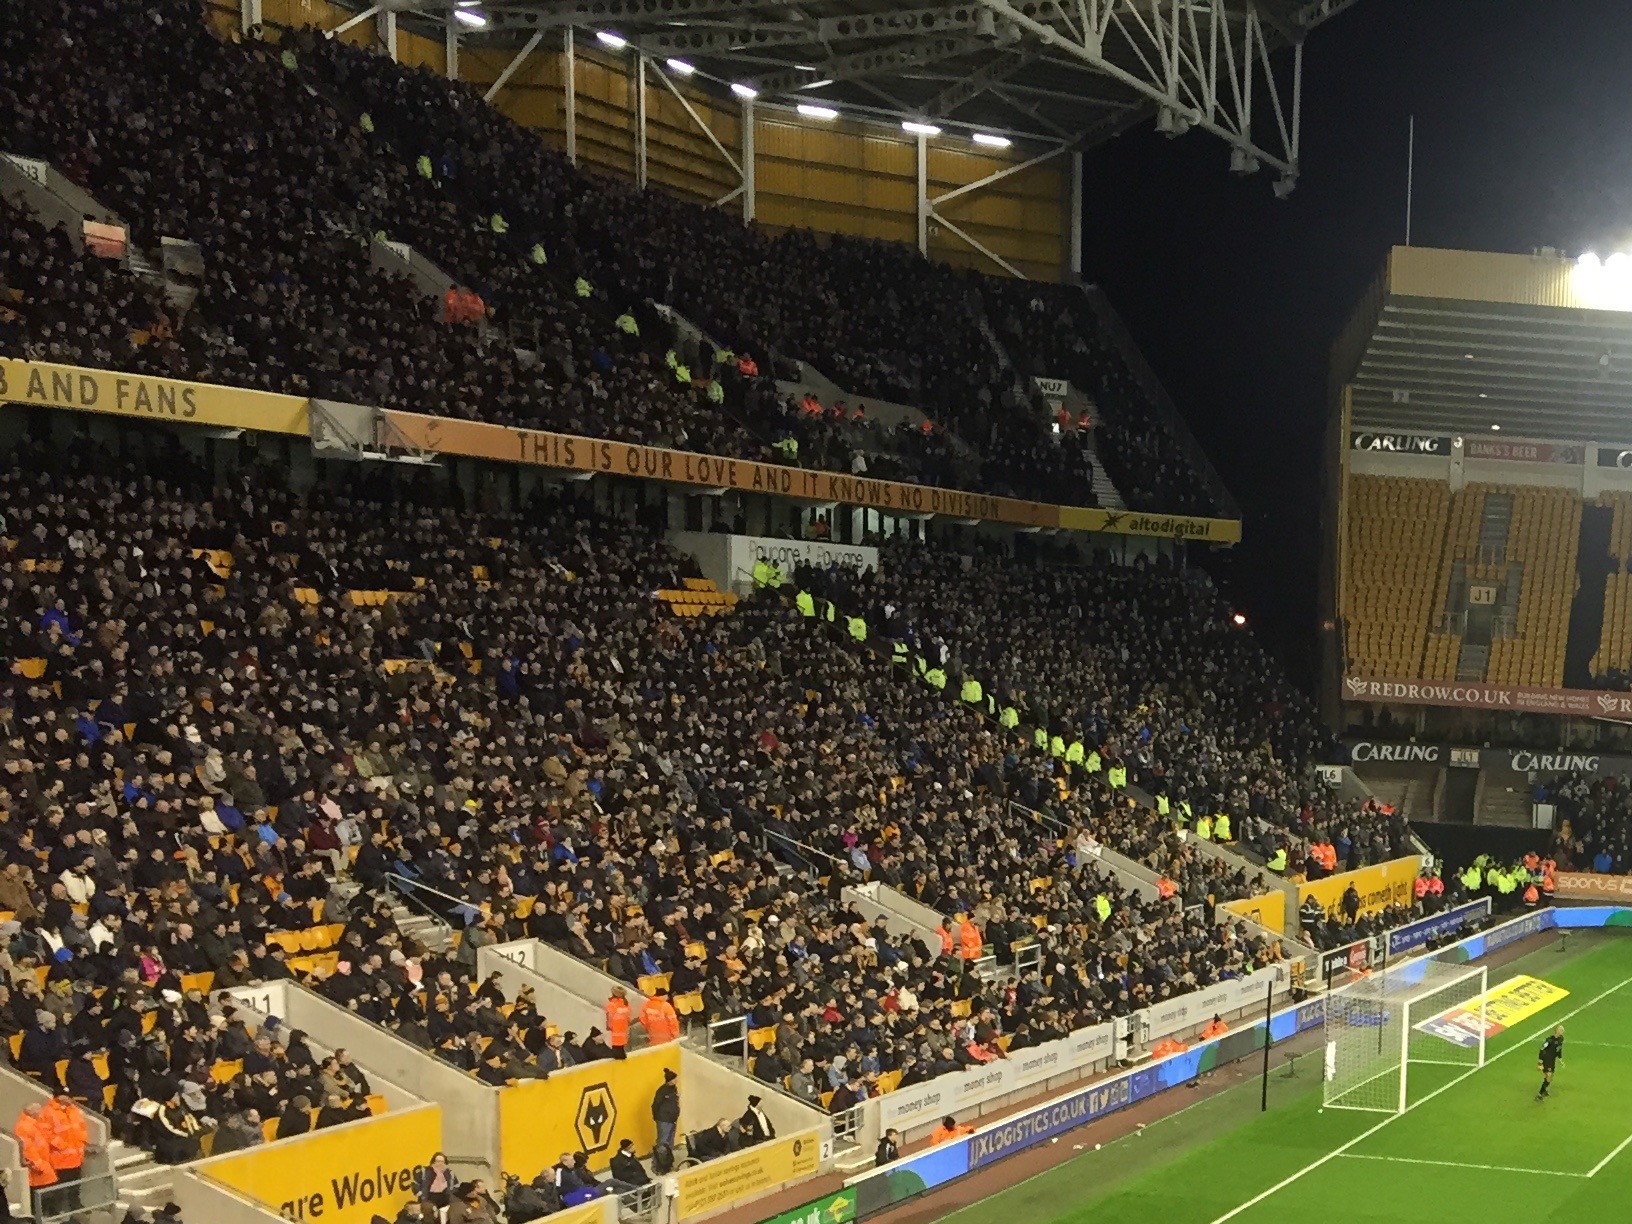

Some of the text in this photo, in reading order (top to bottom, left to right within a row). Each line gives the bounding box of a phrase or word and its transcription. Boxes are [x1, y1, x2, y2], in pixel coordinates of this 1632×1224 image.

[27, 368, 197, 418] AND FANS
[1355, 432, 1439, 452] CARLING
[517, 432, 1000, 518] THIS IS OUR LOVE AND IT KNOWS NO DIVISION
[1129, 518, 1211, 538] altodigital
[1474, 590, 1490, 602] J1
[1370, 682, 1511, 706] REDROW.CO.UK
[1352, 741, 1439, 762] CARLING
[1511, 751, 1600, 773] CARLING
[823, 1143, 830, 1159] 2
[281, 1192, 324, 1219] are
